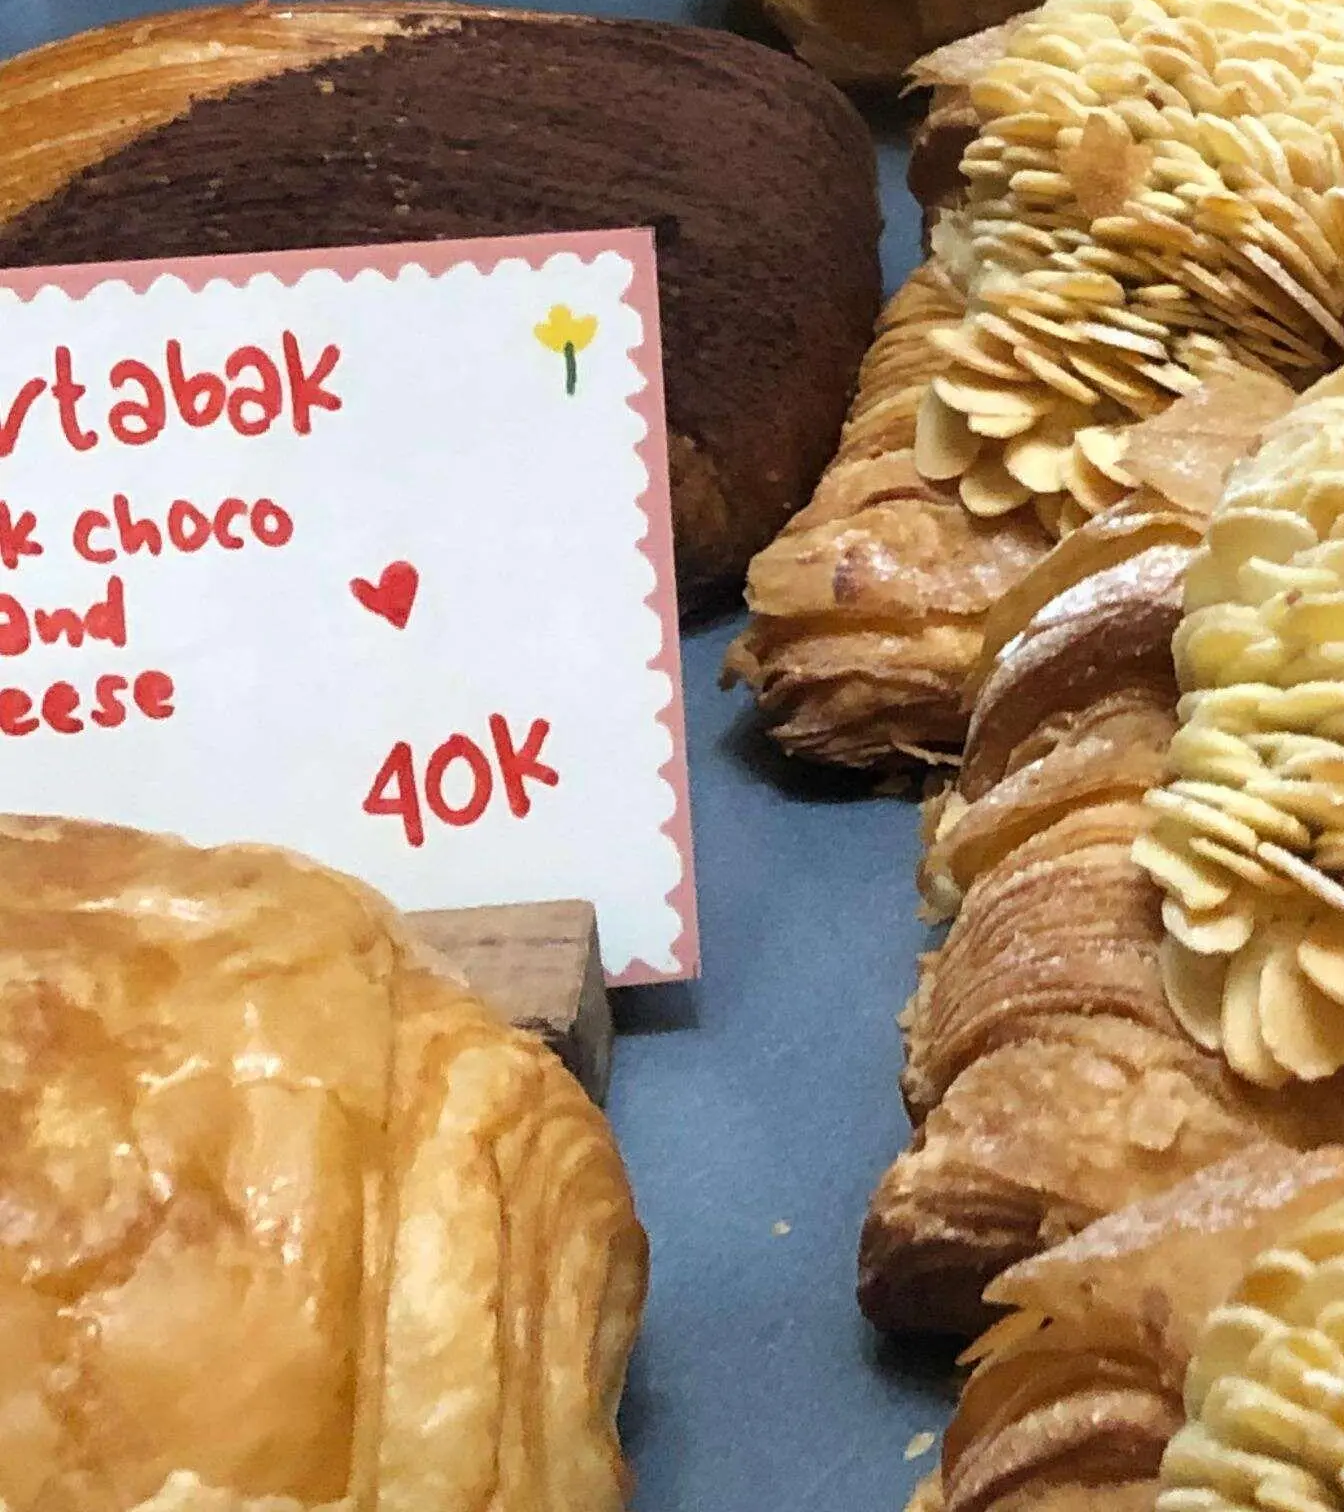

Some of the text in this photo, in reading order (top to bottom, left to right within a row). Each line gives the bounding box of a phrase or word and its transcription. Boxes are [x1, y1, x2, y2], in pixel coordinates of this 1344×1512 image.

[74, 495, 293, 563] choco
[0, 670, 174, 736] eese
[363, 713, 559, 847] 40K
